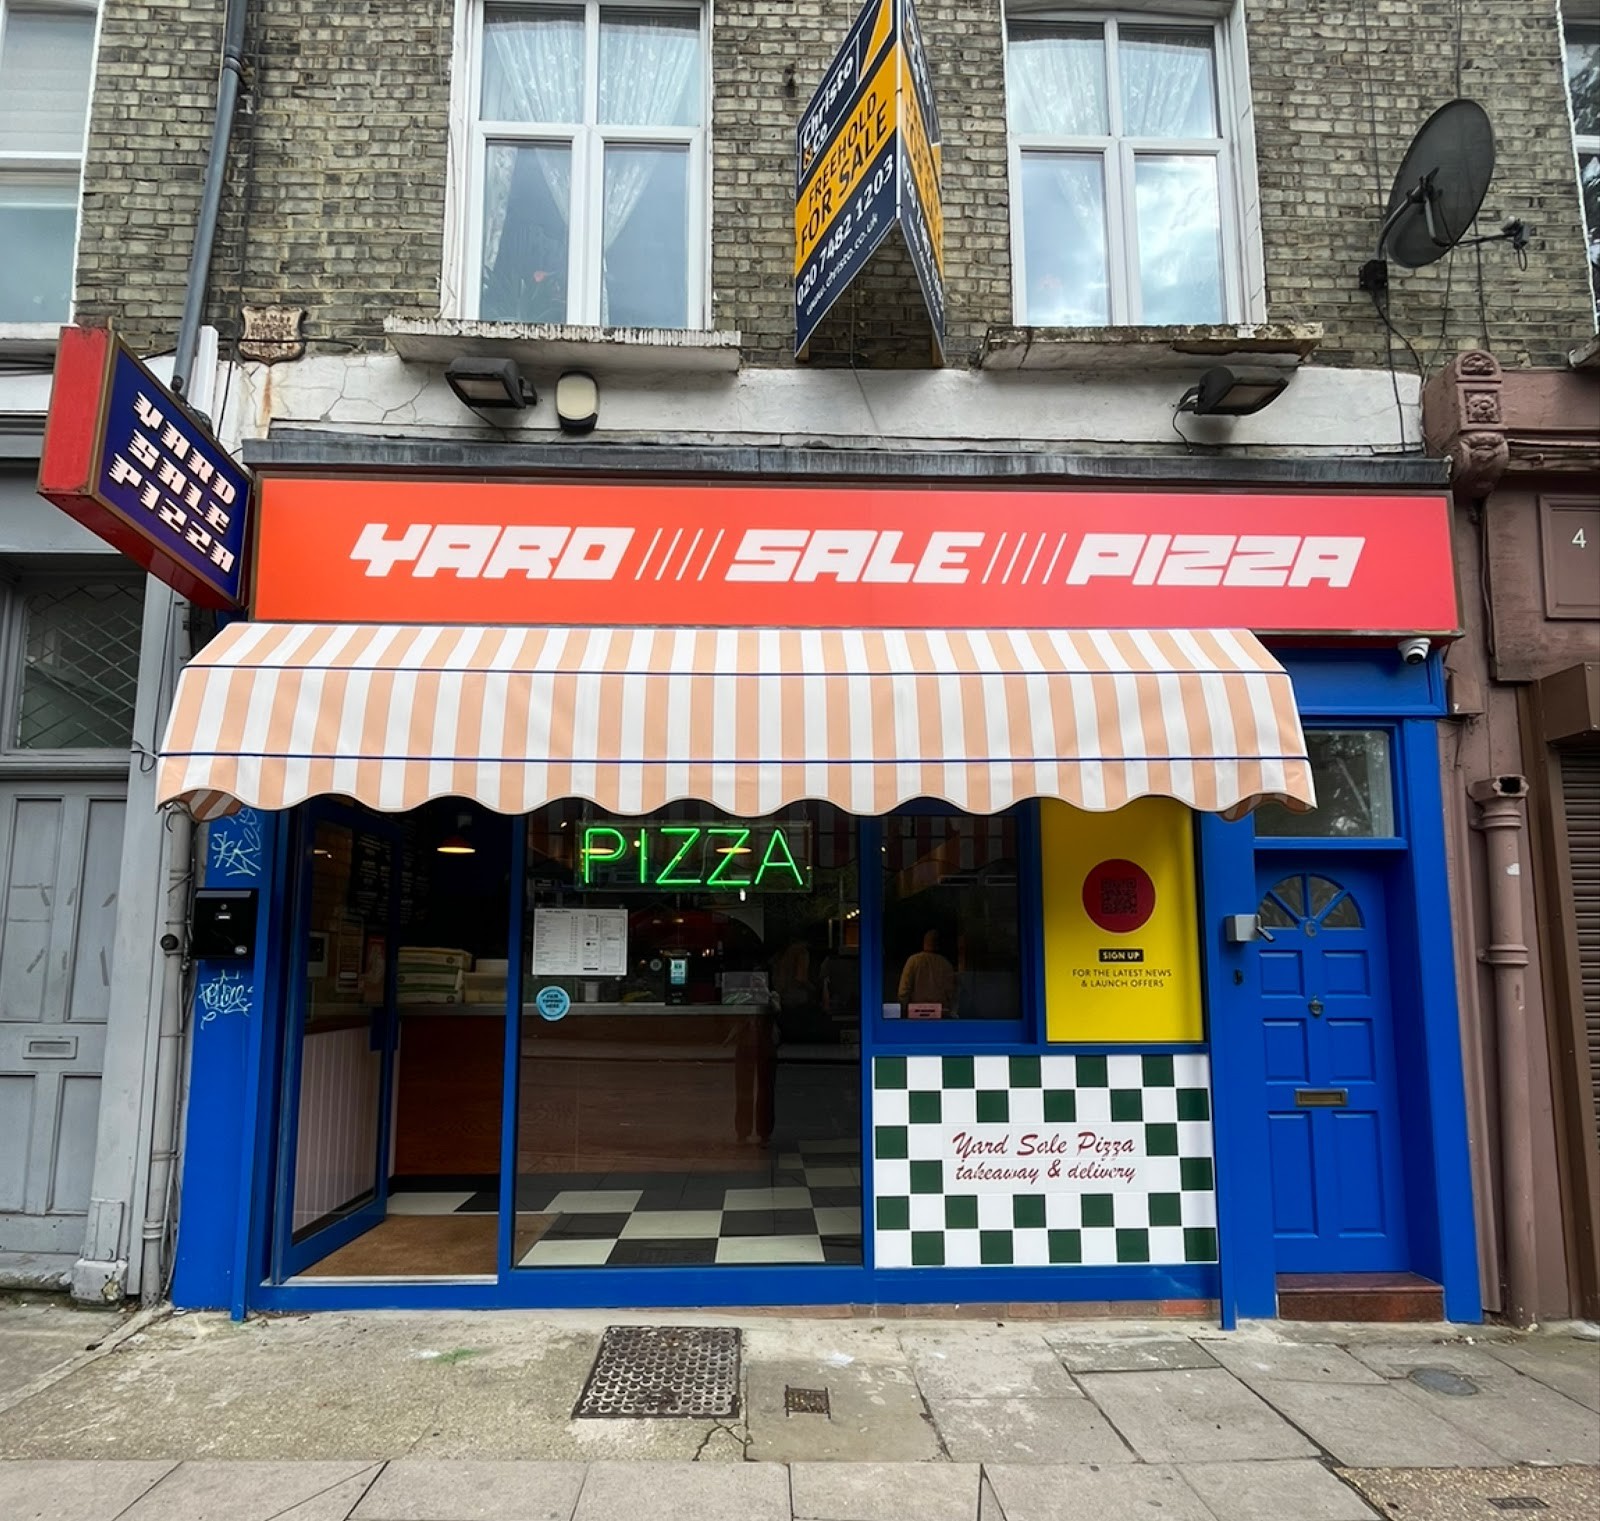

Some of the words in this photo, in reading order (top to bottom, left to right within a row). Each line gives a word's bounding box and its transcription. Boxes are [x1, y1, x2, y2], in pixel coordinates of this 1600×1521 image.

[803, 56, 854, 149] Christo
[801, 187, 832, 258] FOR
[839, 98, 888, 198] SALE
[809, 91, 877, 211] FREEHOLD
[797, 264, 817, 306] 020
[819, 213, 853, 274] 7482
[855, 153, 893, 222] 1203
[133, 391, 236, 505] YARD
[108, 453, 235, 573] PIZZA
[127, 429, 230, 535] SALE
[349, 523, 636, 580] YARD
[724, 529, 986, 583] SALE
[1066, 533, 1366, 588] PIZZA
[1571, 528, 1587, 548] 4
[582, 827, 804, 886] PIZZA
[1072, 969, 1091, 977] FOR
[1093, 969, 1110, 977] THE
[1112, 969, 1143, 977] LATEST
[1145, 969, 1172, 977] NEWS
[1081, 980, 1088, 988] &
[1090, 980, 1128, 988] LAUNCH
[1130, 980, 1164, 988] OFFERS
[1103, 951, 1125, 960] SIGN
[1127, 951, 1140, 960] UP
[952, 1131, 1010, 1159] Yard
[1077, 1131, 1136, 1160] Pizza
[955, 1160, 1040, 1185] takeaway
[1047, 1158, 1061, 1179] &
[1067, 1160, 1136, 1184] delivery
